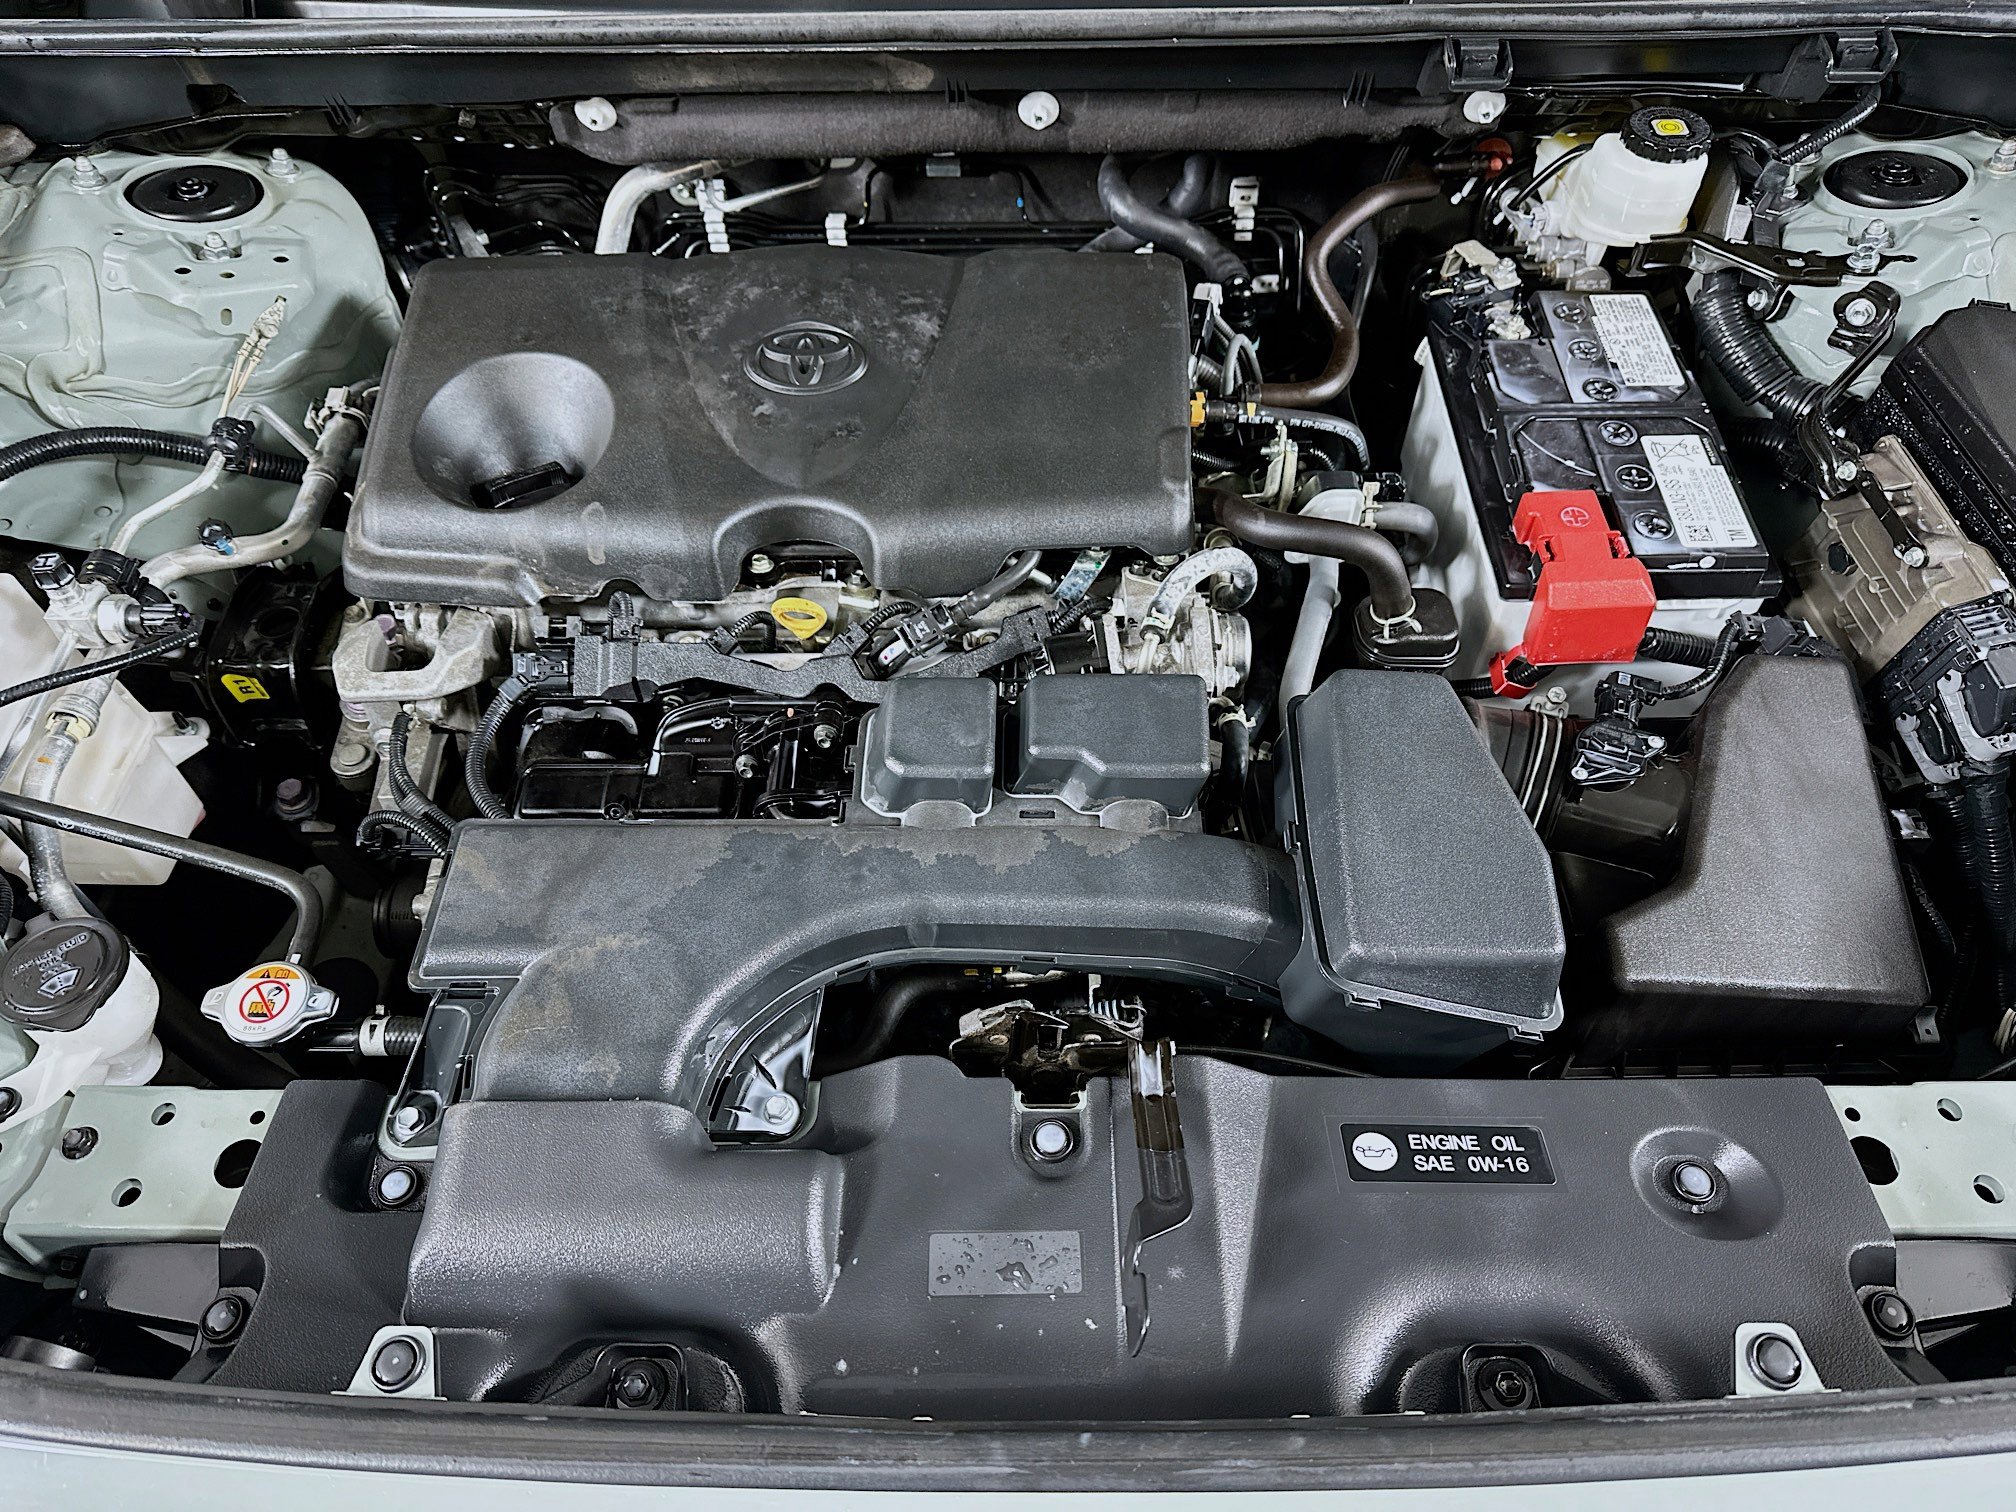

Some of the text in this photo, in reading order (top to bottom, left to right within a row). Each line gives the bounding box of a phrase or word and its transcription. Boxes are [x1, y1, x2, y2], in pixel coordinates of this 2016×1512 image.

[232, 679, 255, 694] R1
[59, 934, 87, 951] FLUID
[39, 952, 65, 969] ONLY
[1407, 1134, 1525, 1152] ENGINE OIL
[1414, 1155, 1530, 1173] SAE 0W-16
